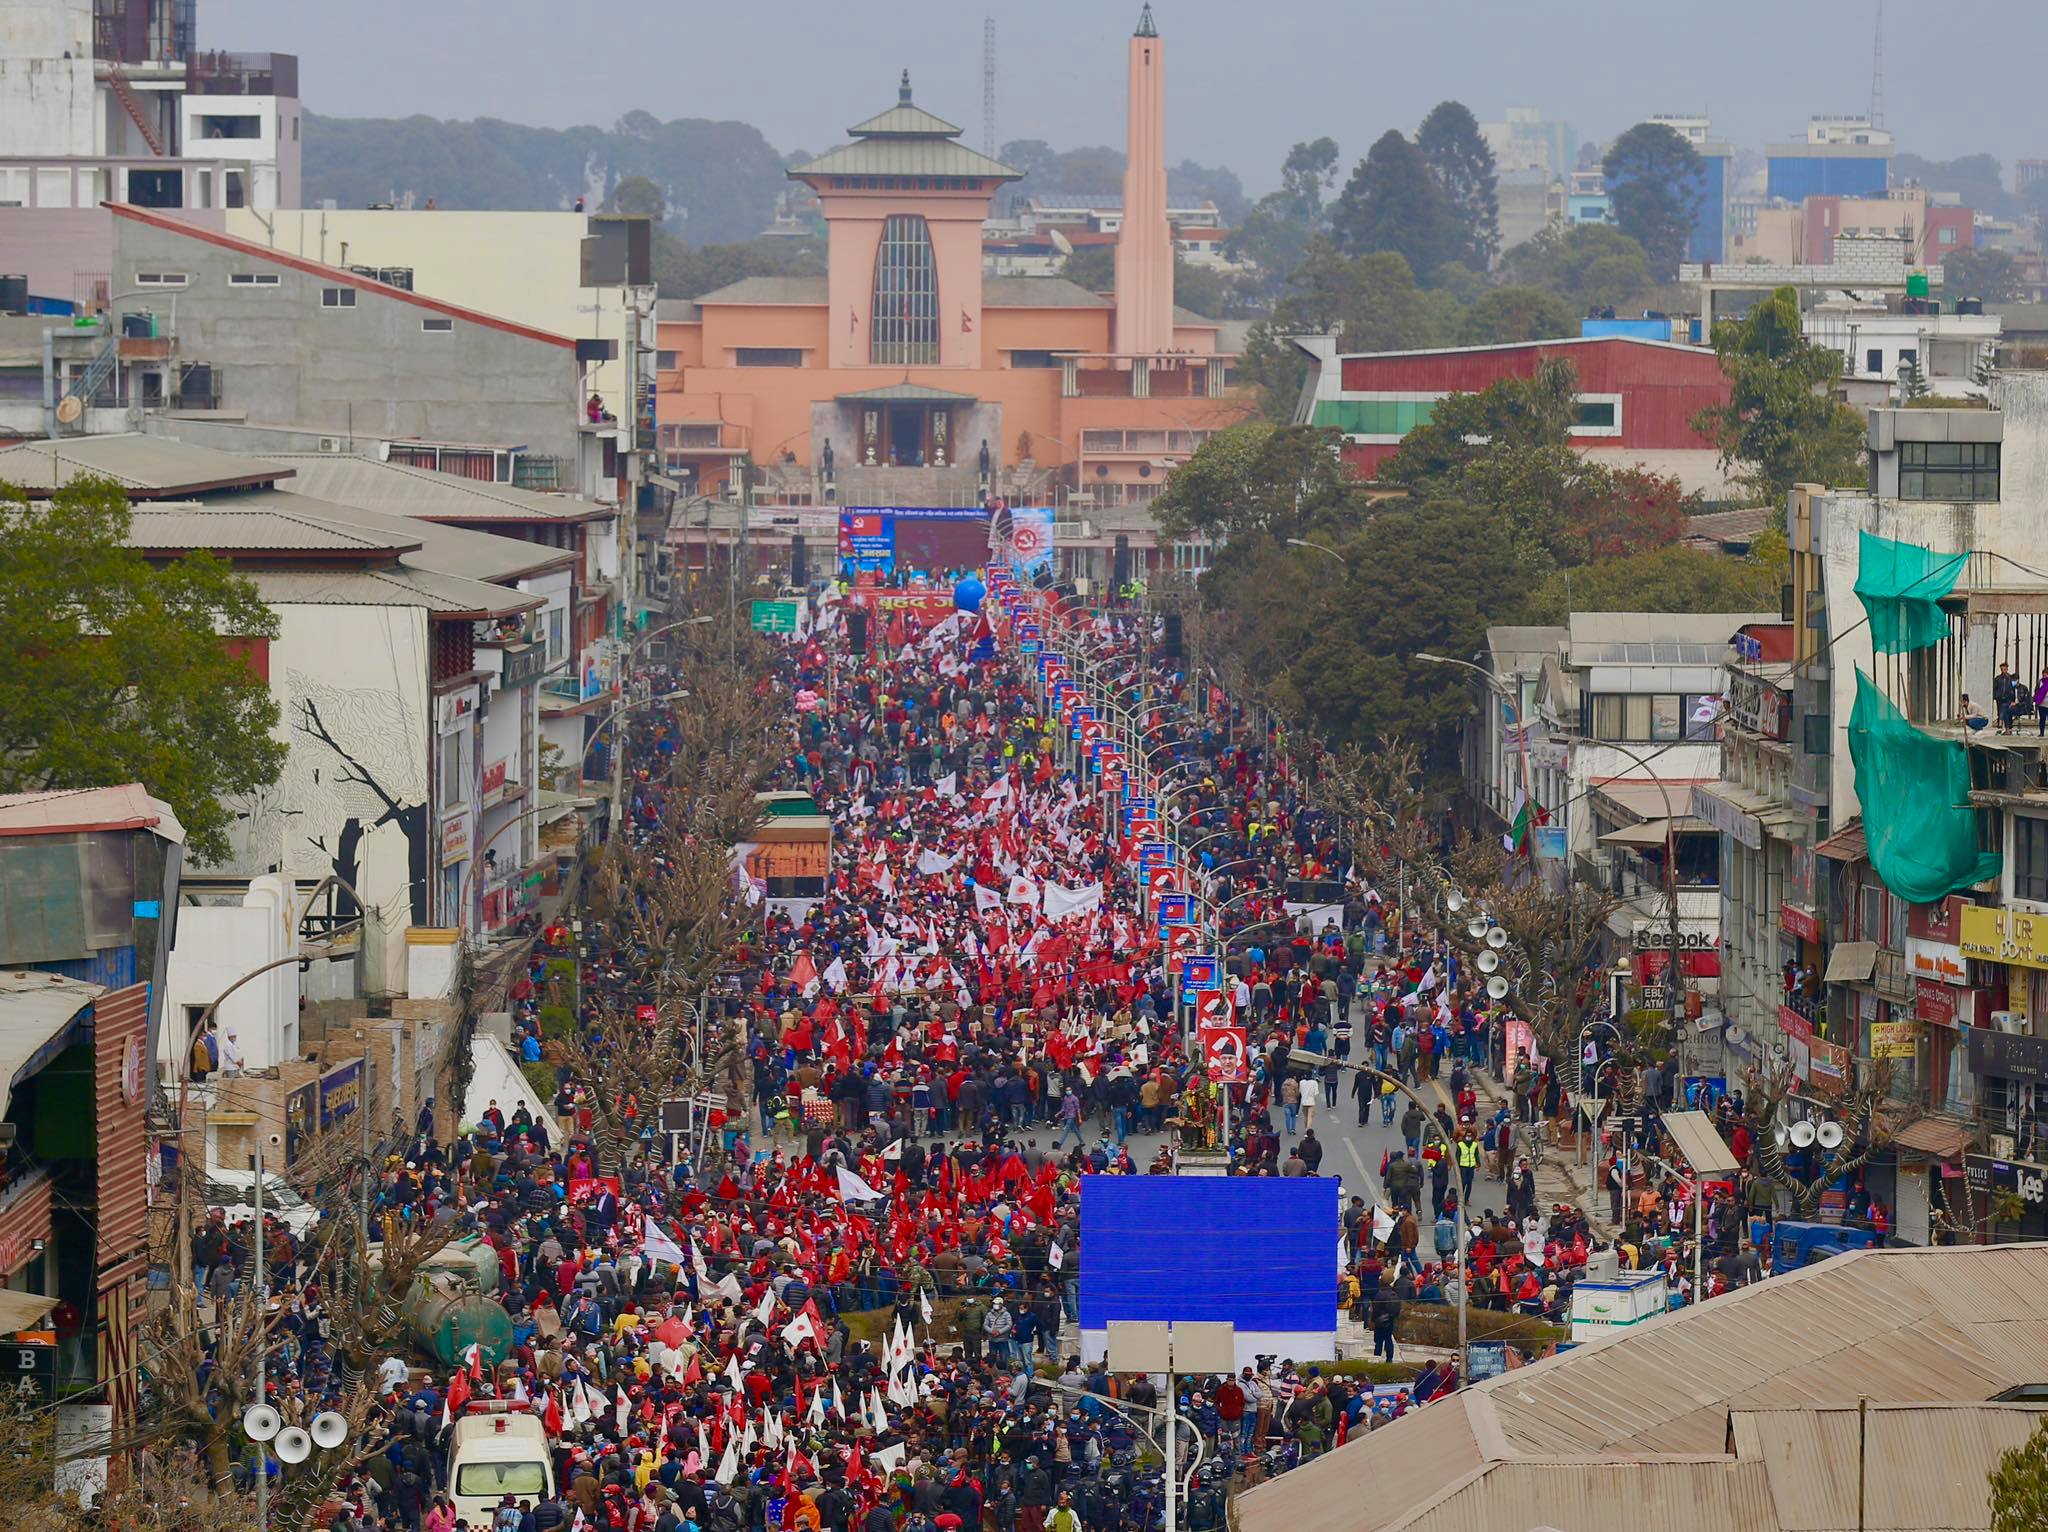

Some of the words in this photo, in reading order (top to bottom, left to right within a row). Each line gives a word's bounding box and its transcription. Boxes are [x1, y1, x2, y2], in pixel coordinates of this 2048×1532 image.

[1644, 988, 1664, 998] EBL
[1644, 999, 1664, 1009] ATM
[1880, 1024, 1895, 1033] HIGH
[2016, 1169, 2044, 1204] Lee
